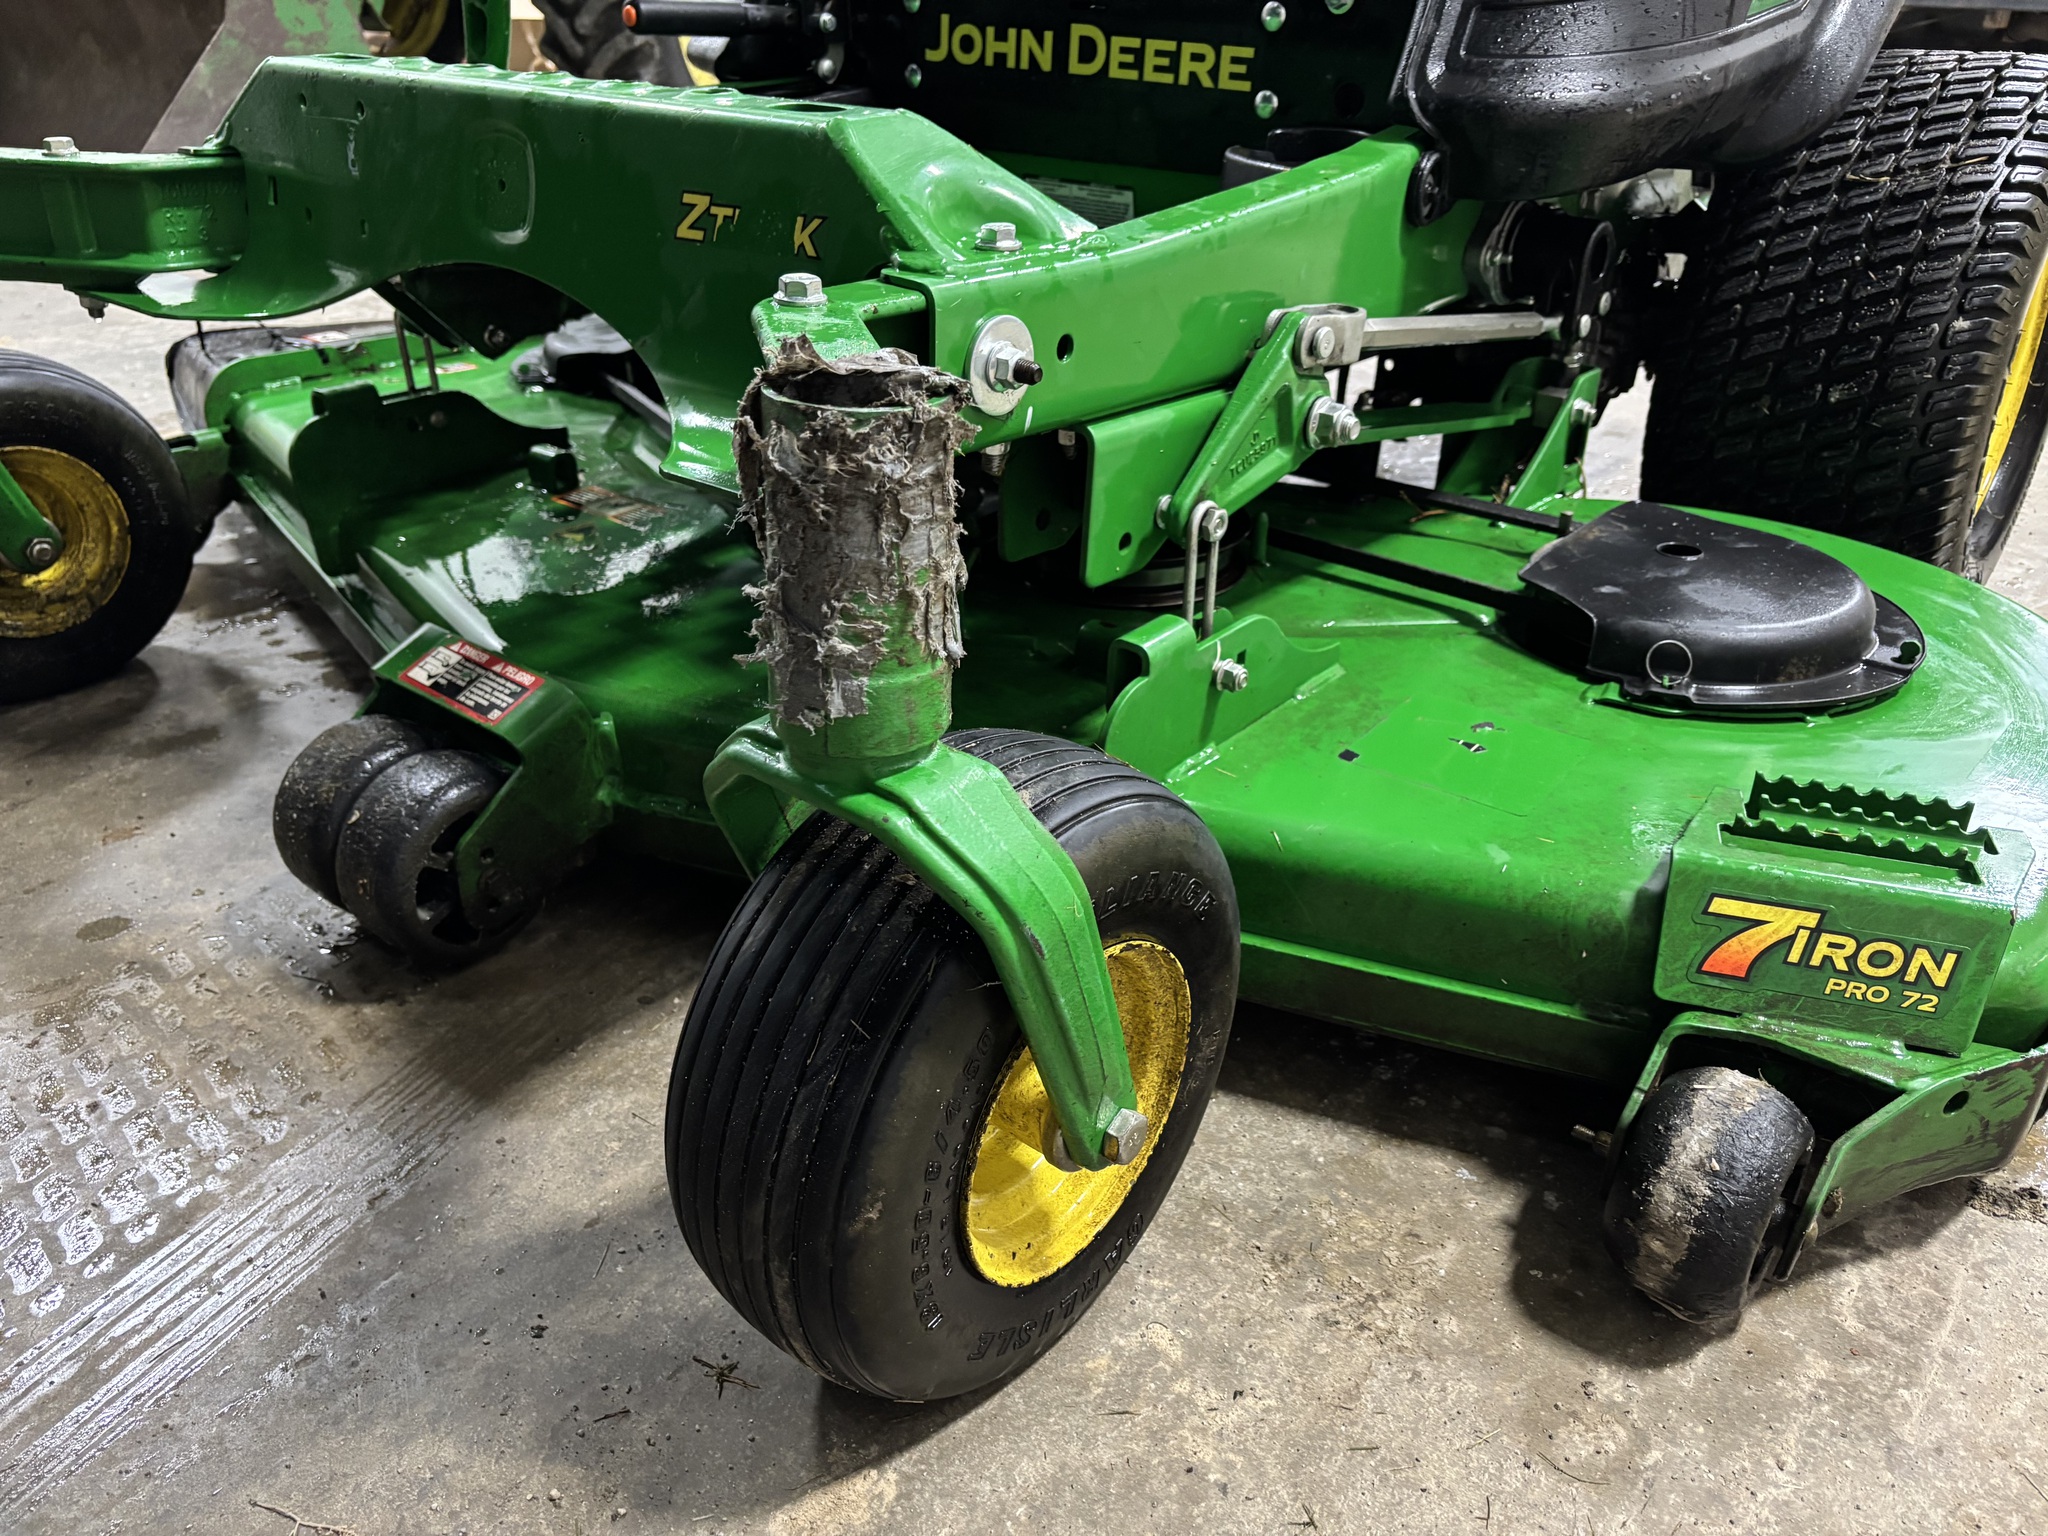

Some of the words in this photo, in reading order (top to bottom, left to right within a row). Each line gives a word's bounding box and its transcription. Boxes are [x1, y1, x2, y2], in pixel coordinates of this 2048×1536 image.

[925, 13, 1054, 72] JOHN
[1068, 23, 1255, 92] DEERE
[460, 643, 491, 664] DANGER
[502, 664, 537, 687] PELIGRO
[1823, 977, 1890, 1004] PRO
[1899, 990, 1941, 1014] 72
[967, 1212, 1144, 1361] CARLISLE
